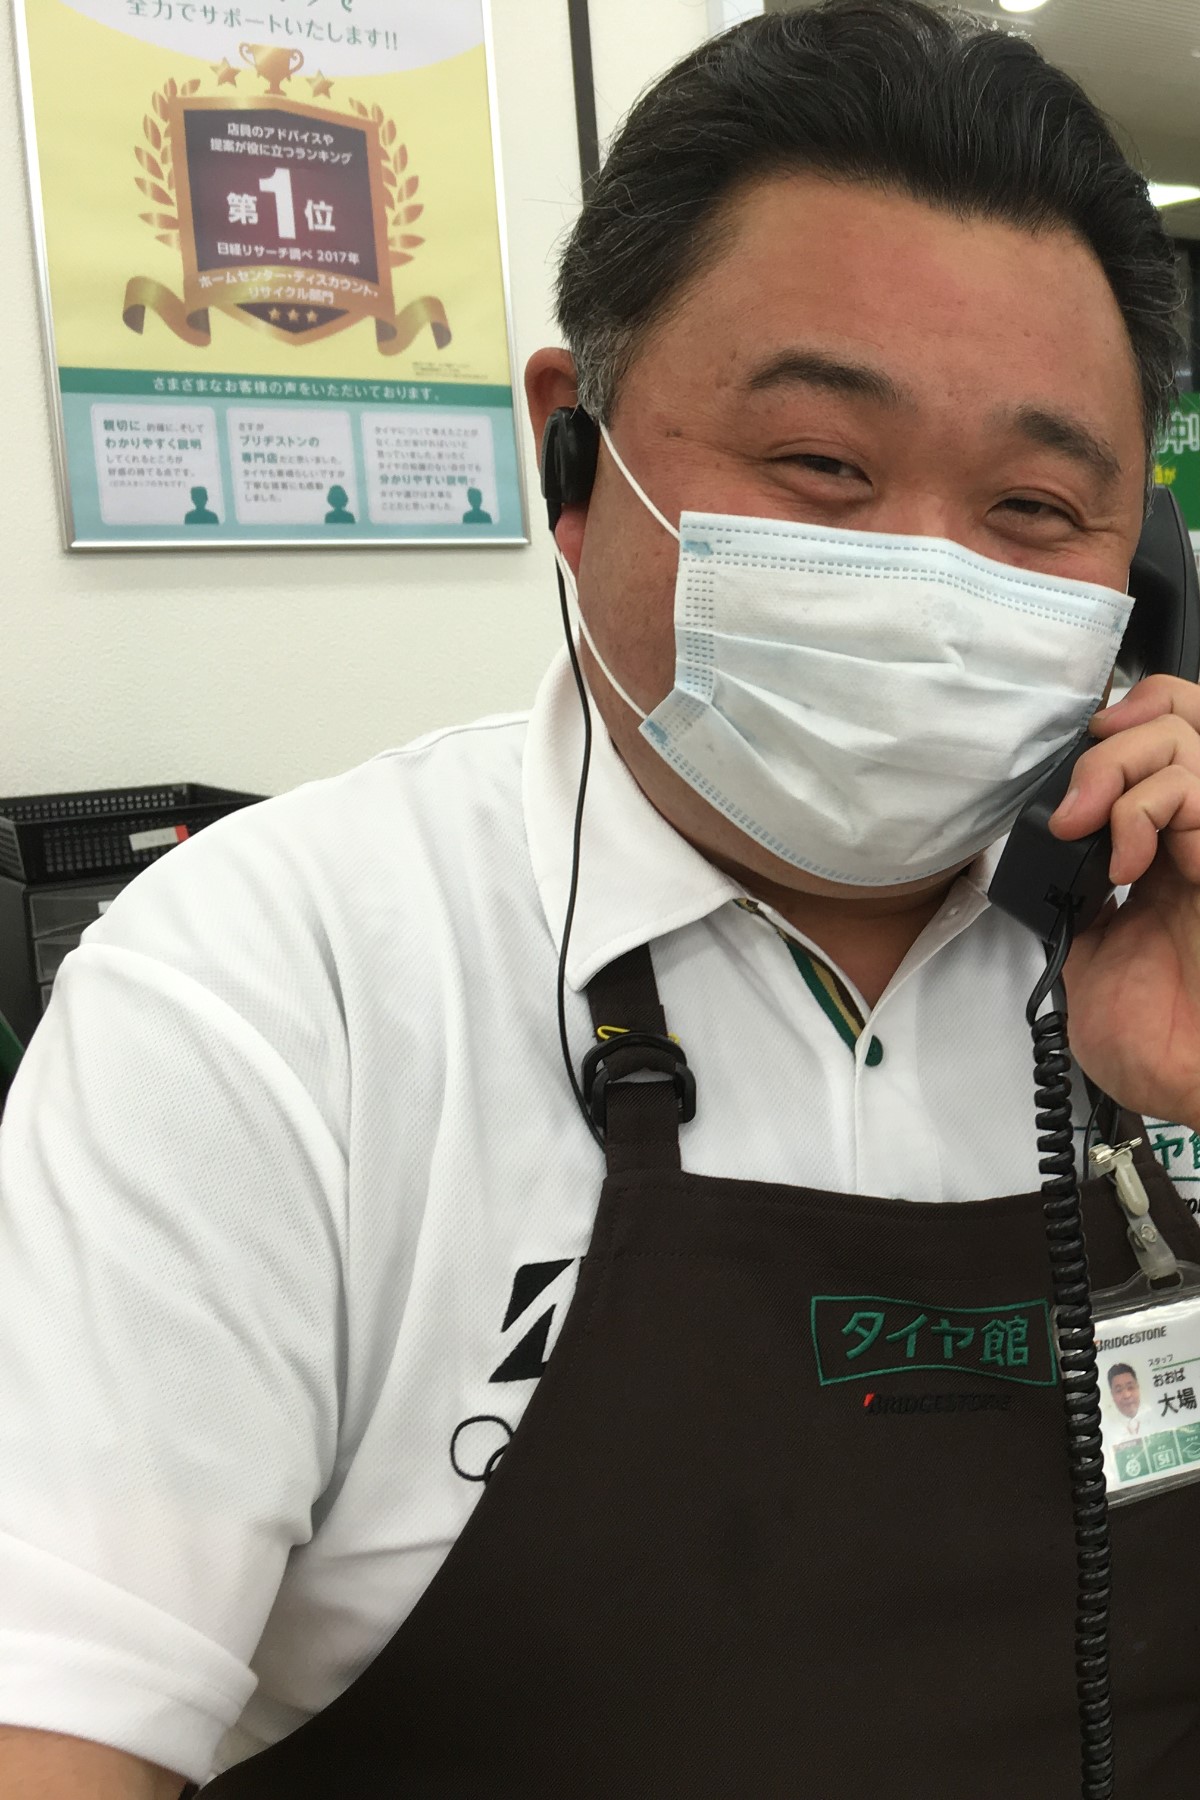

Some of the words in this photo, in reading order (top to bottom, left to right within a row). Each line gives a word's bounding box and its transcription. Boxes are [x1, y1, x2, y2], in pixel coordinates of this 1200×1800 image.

[227, 122, 334, 147] 店員のアドバイスや
[210, 138, 352, 165] 提案が役に立つランキング
[841, 1311, 1029, 1367] タイヤ館
[1094, 1325, 1167, 1353] BRIDGESTONE
[1153, 1368, 1186, 1388] おおば
[1158, 1387, 1198, 1417] 大場
